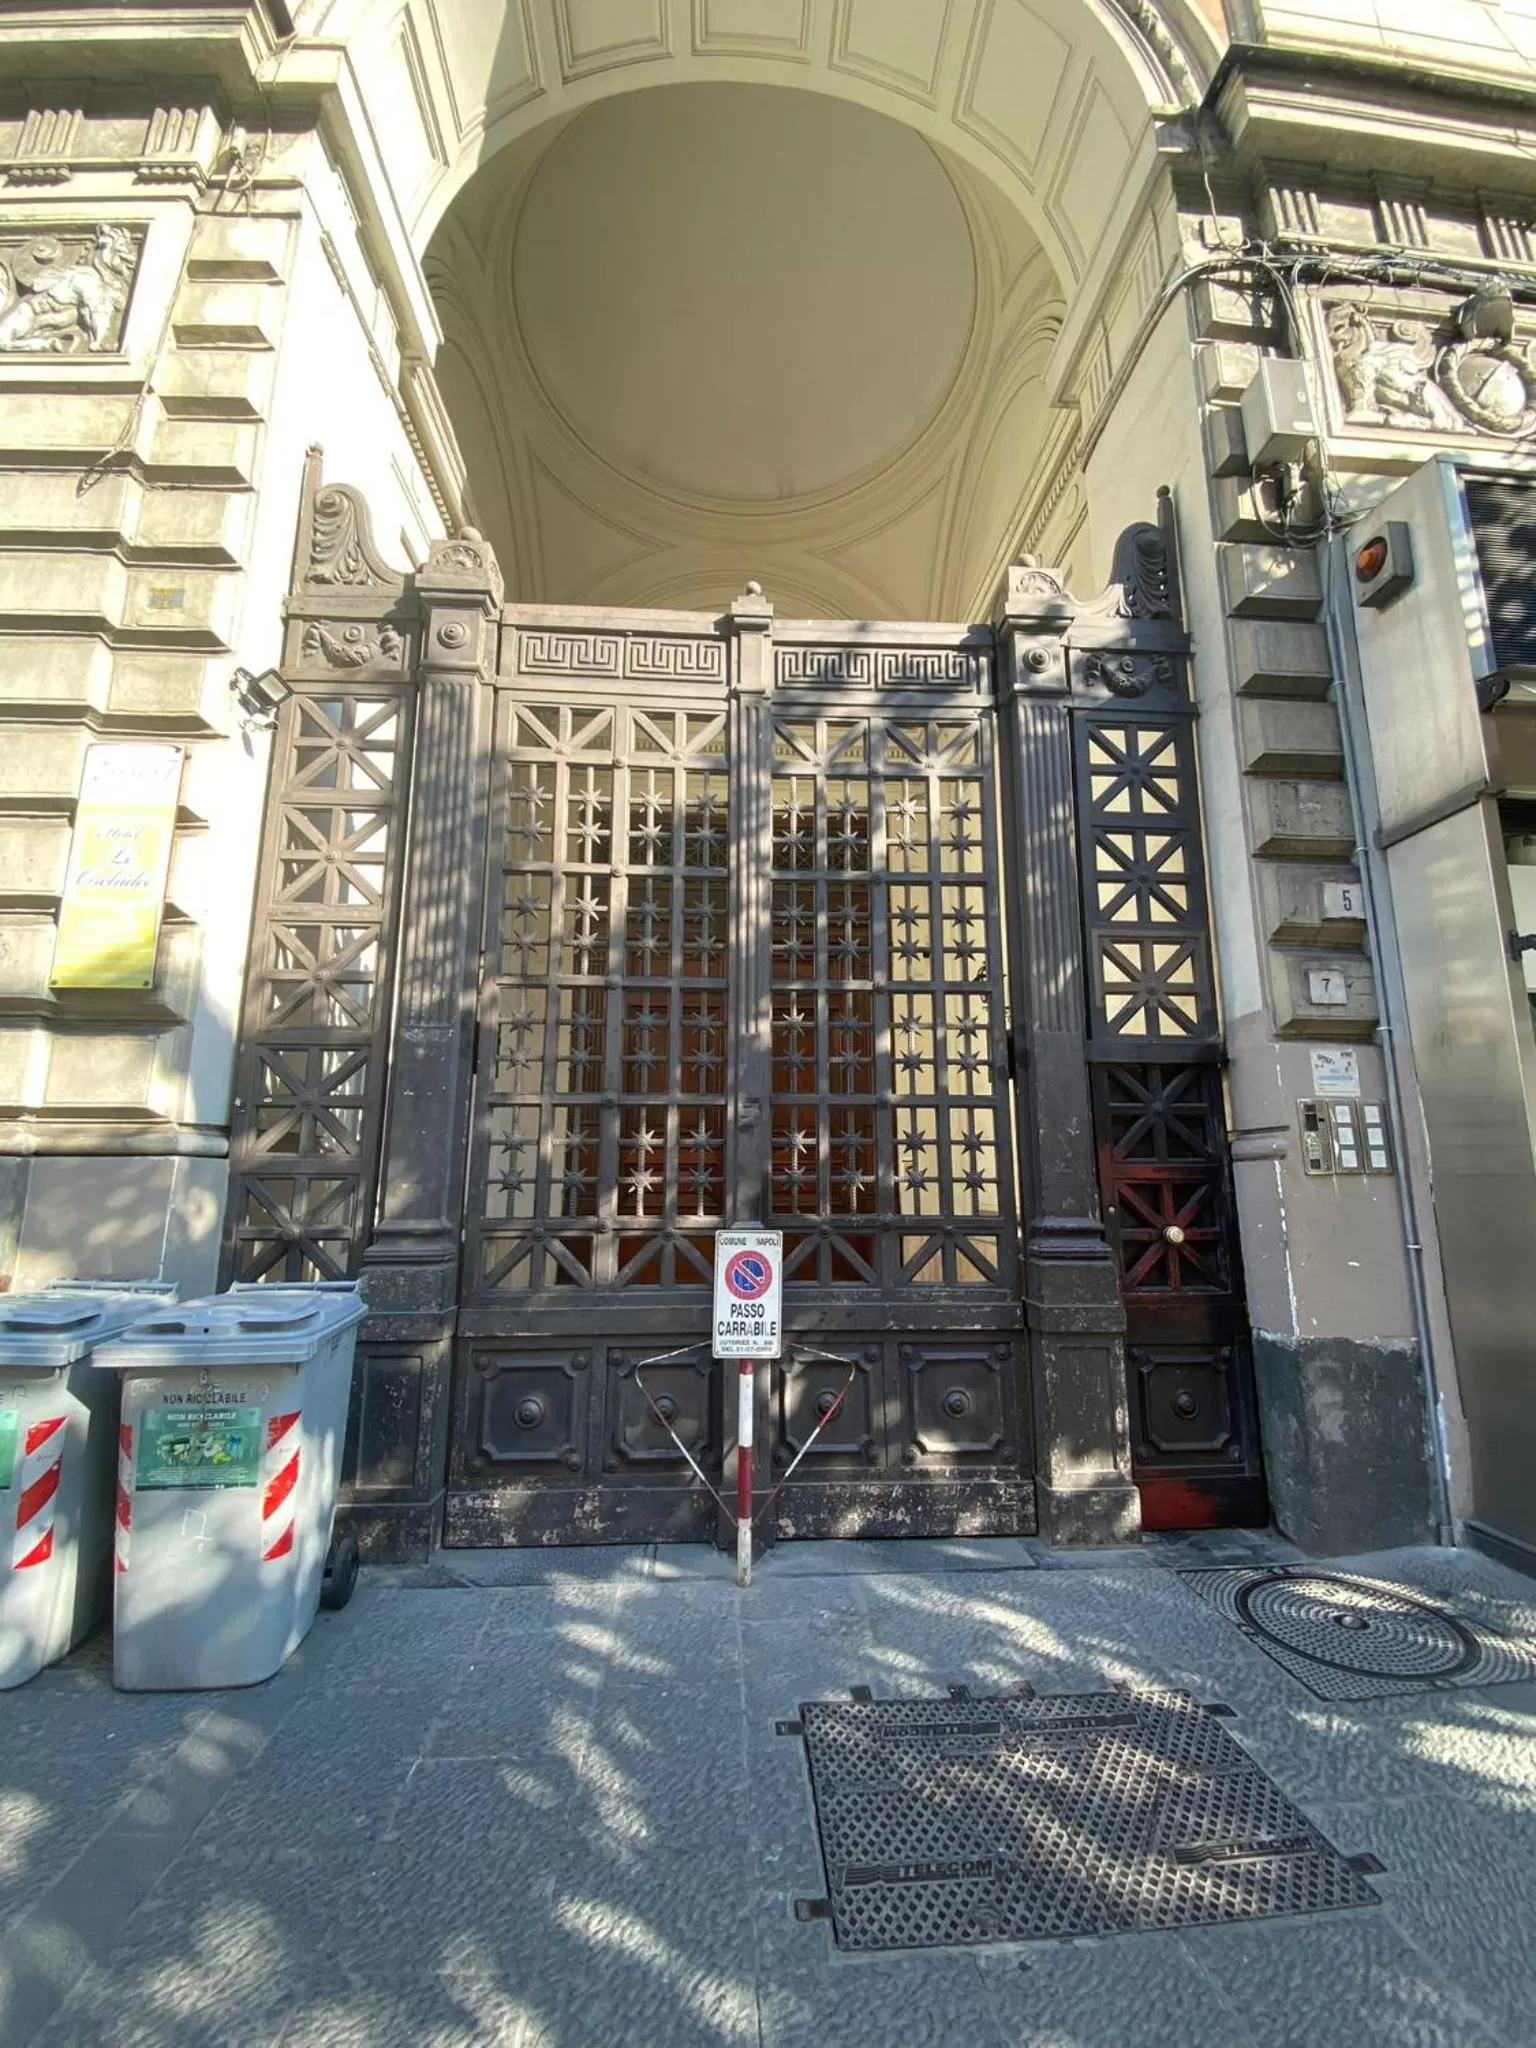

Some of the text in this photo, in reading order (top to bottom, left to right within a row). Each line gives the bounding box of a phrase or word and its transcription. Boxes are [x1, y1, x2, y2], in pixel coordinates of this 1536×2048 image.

[1342, 889, 1353, 912] 5
[1321, 978, 1331, 993] 7
[720, 1237, 779, 1246] COMUNE NAPOLI
[730, 1303, 765, 1318] PASSO
[717, 1321, 777, 1336] CARRABILE
[163, 1391, 247, 1405] NON RICCLABILE
[899, 1860, 993, 1878] TELECOM
